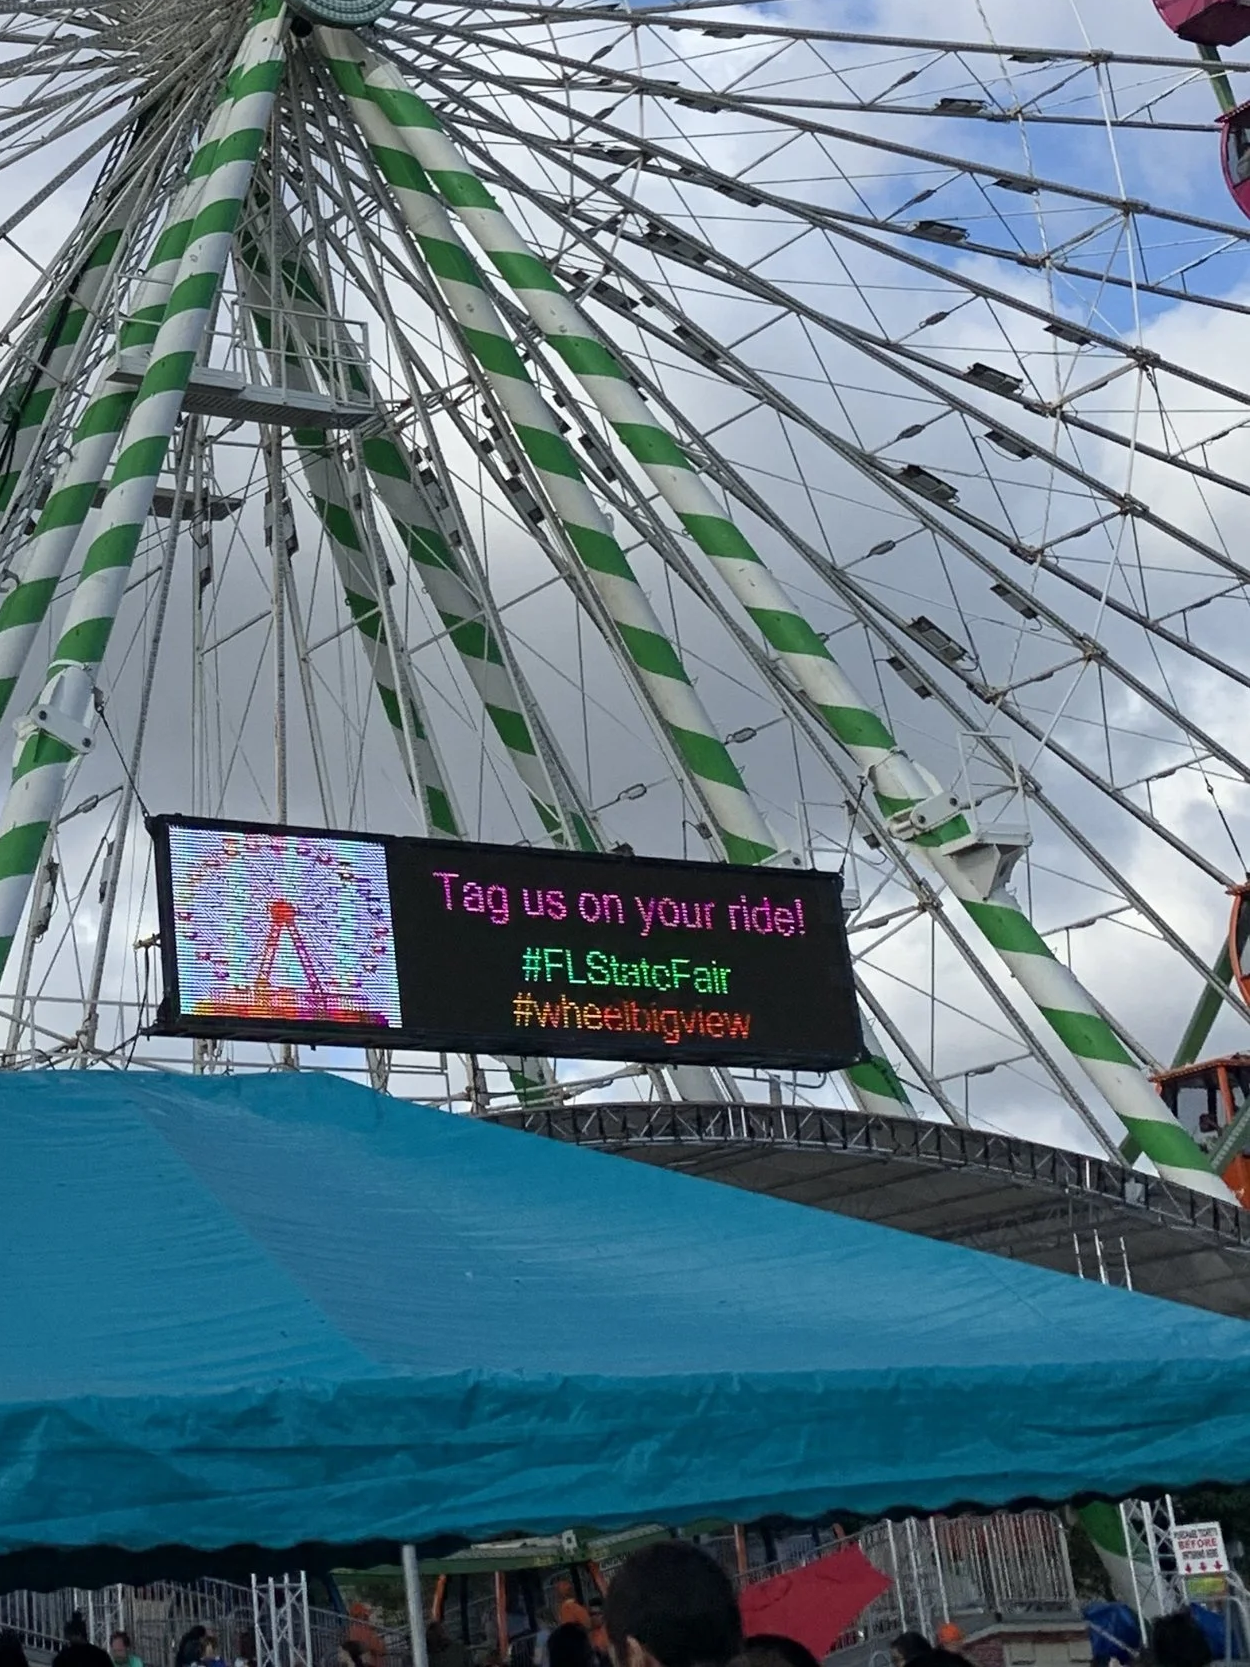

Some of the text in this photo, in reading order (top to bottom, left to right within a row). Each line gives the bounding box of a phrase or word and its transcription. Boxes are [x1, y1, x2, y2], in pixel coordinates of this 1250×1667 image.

[432, 871, 806, 937] Tag us on your ride!
[512, 991, 751, 1045] #wheelbigview
[1177, 1537, 1218, 1550] BEFORE
